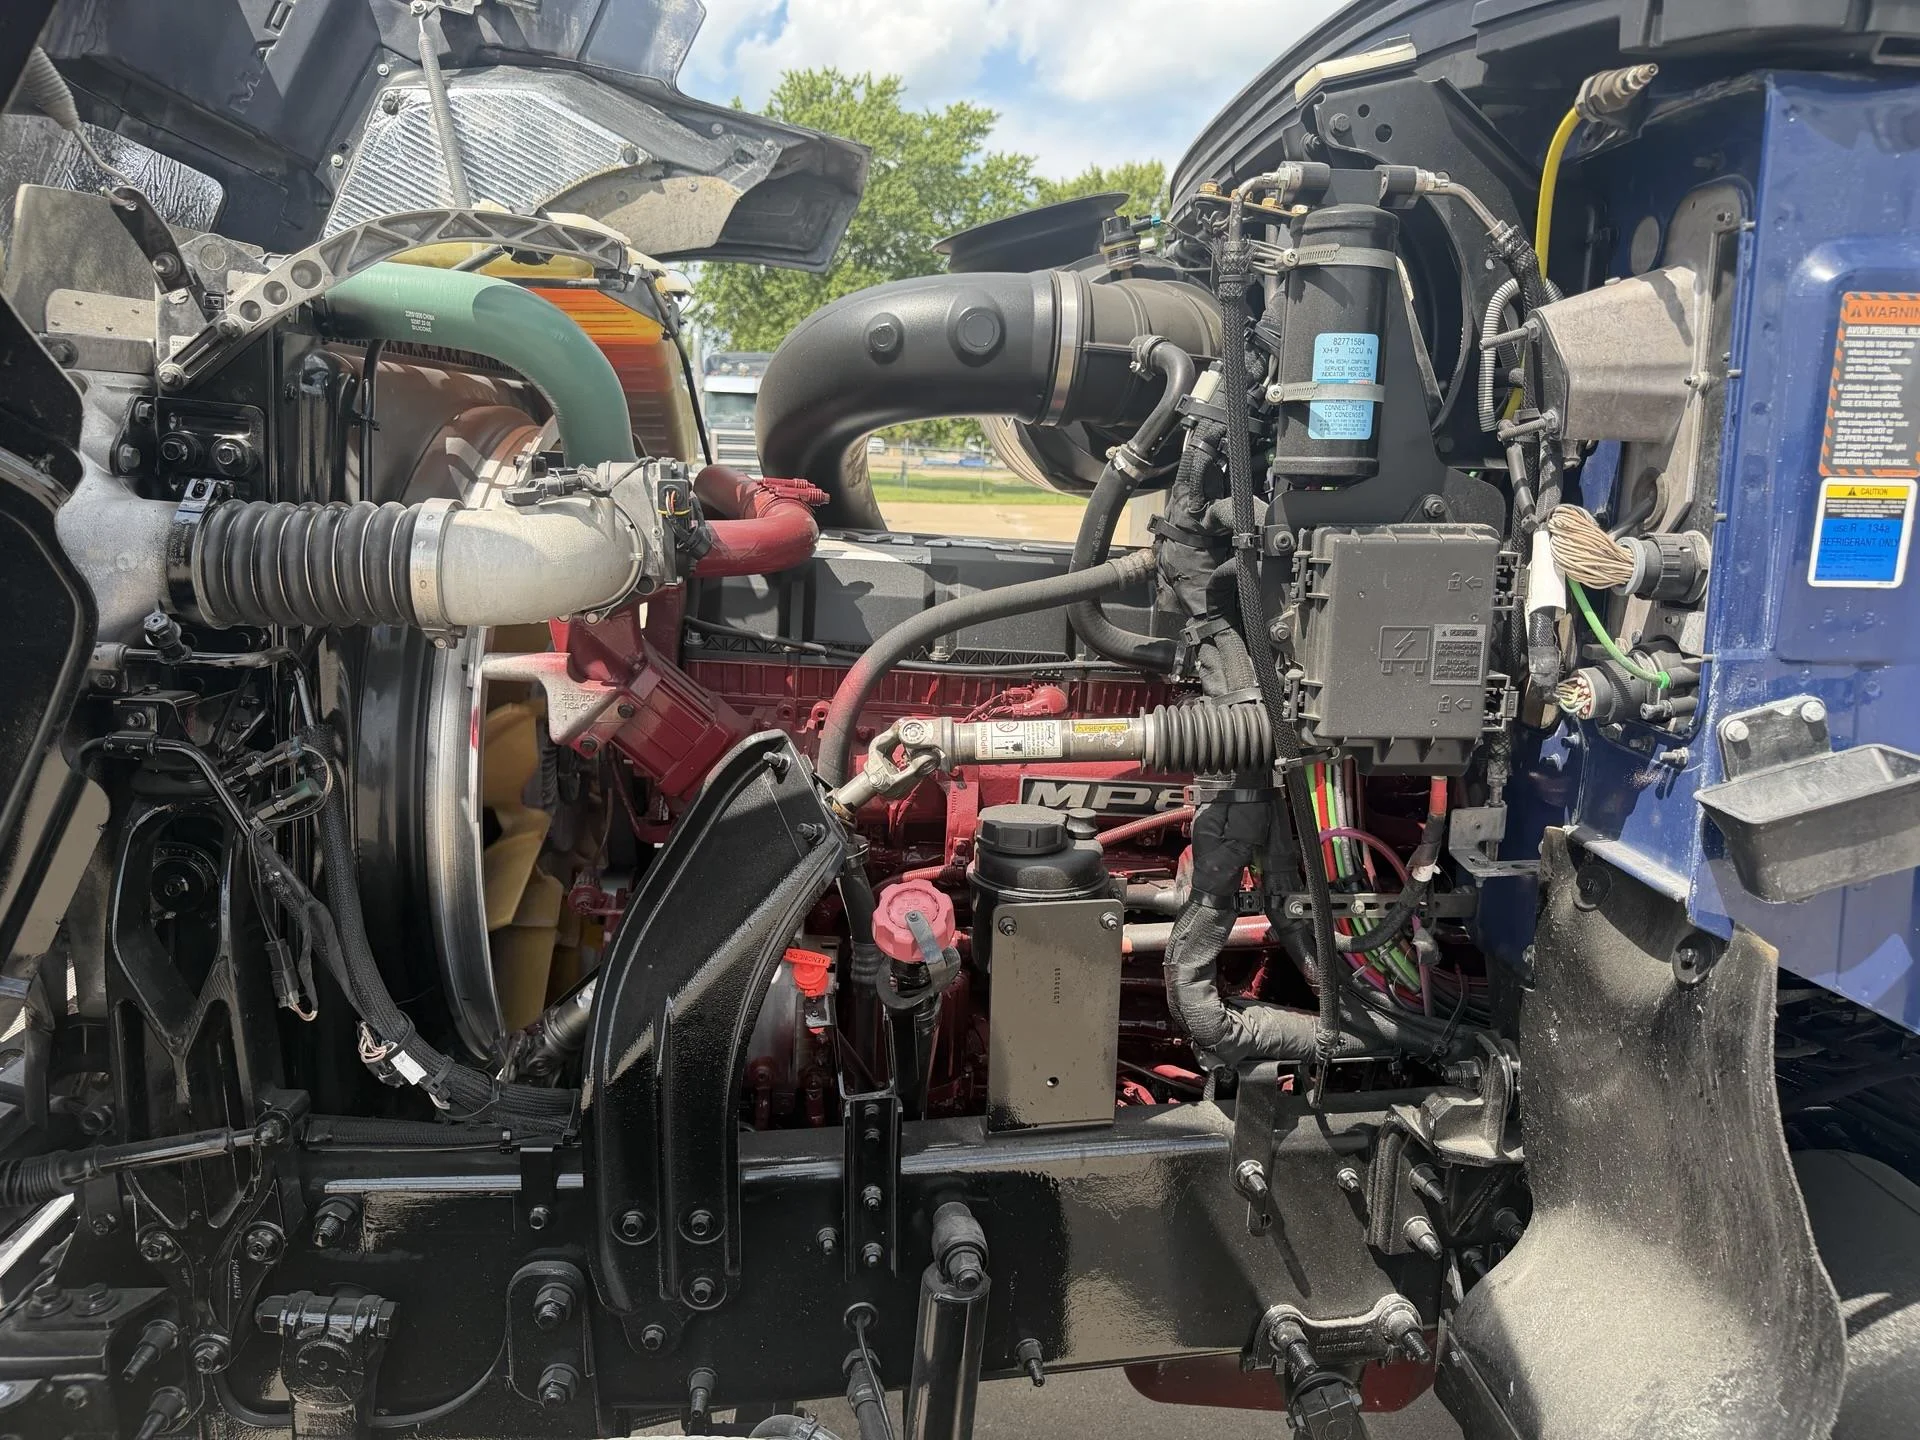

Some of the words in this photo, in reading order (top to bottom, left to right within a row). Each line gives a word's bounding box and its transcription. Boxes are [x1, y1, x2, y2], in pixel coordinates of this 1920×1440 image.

[1861, 487, 1888, 496] CAUTION
[1821, 537, 1876, 547] REFRIGERANT
[1878, 538, 1898, 548] ONLY
[1027, 781, 1187, 812] MP8
